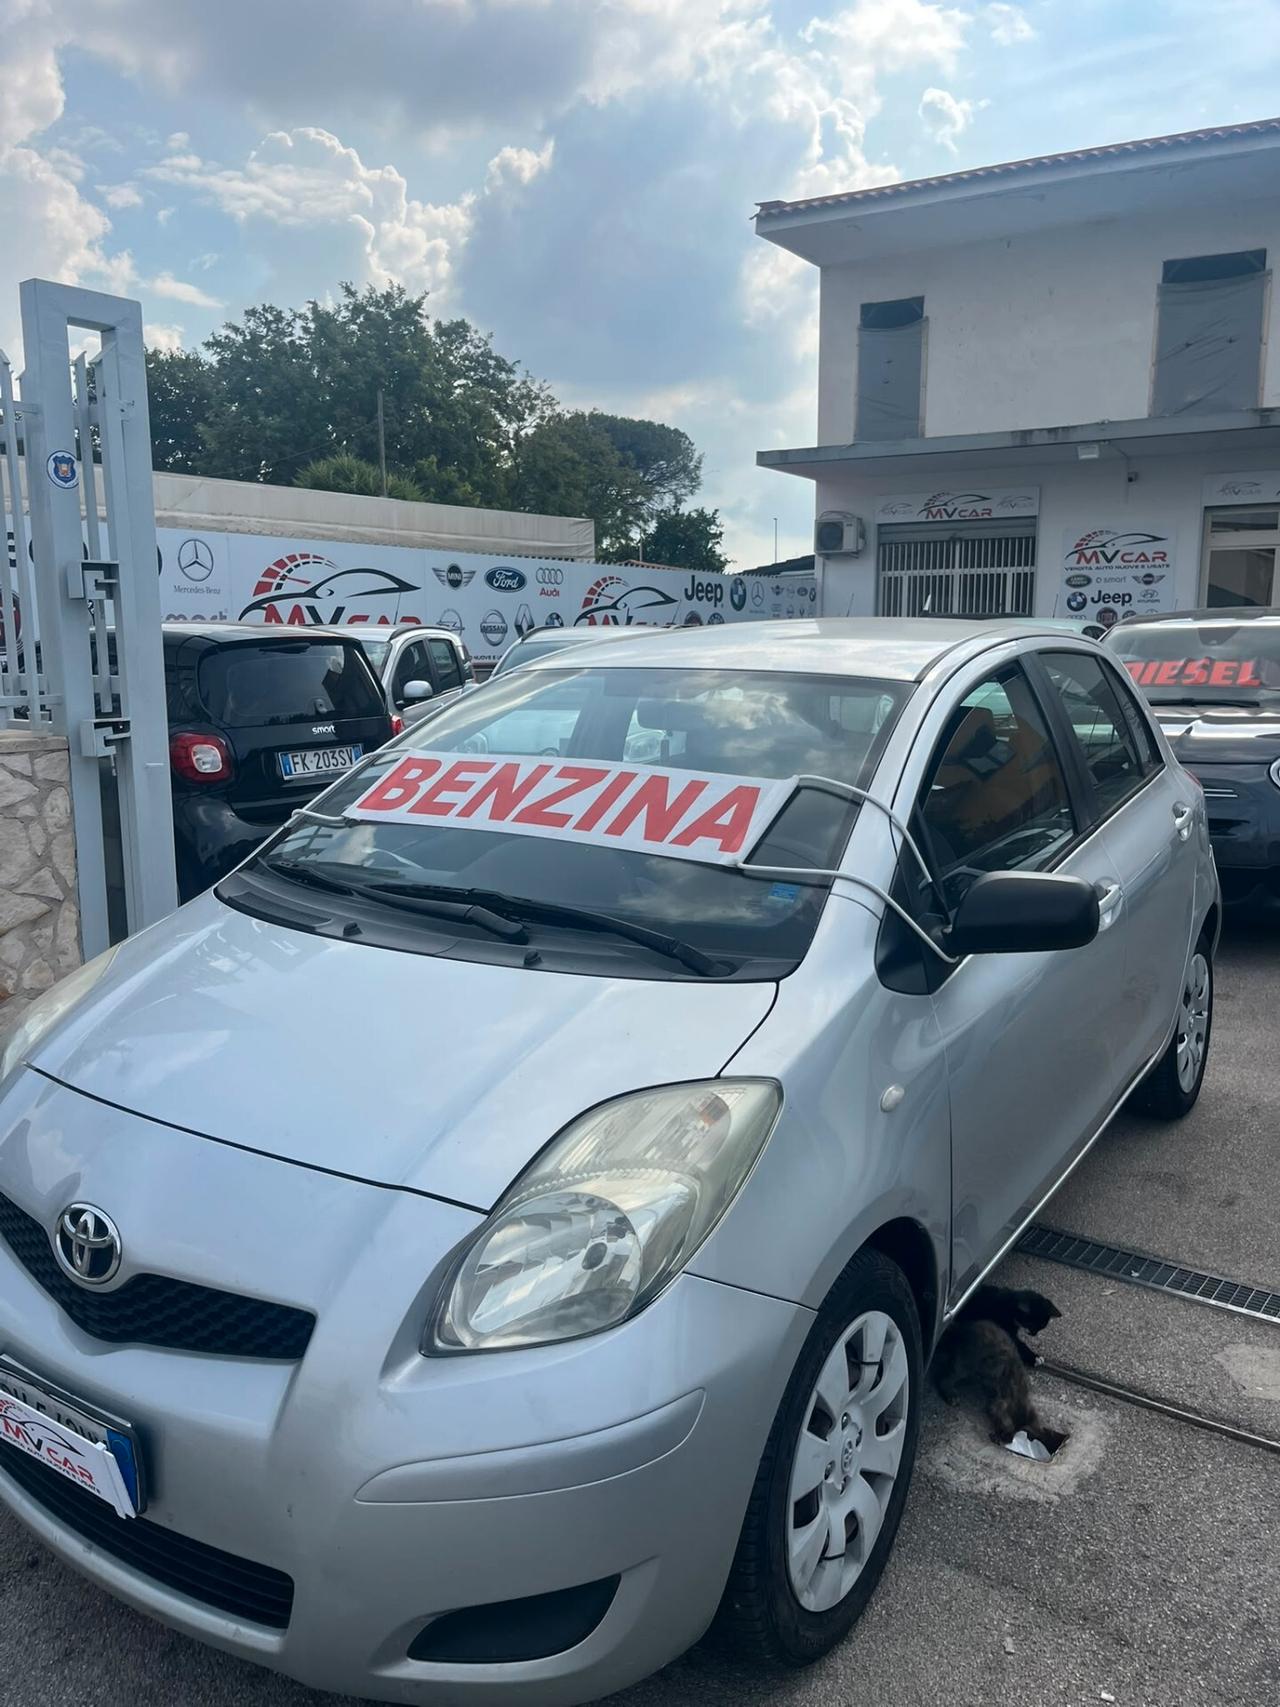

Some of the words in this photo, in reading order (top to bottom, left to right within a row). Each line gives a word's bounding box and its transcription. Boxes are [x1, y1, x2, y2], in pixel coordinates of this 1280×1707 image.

[492, 570, 519, 589] Ford
[173, 585, 221, 594] Mercedes-Benz
[539, 588, 560, 597] Audi
[684, 574, 723, 607] Jeep
[1090, 590, 1132, 606] Jeep
[312, 725, 336, 735] smart
[356, 757, 761, 853] BENZINA
